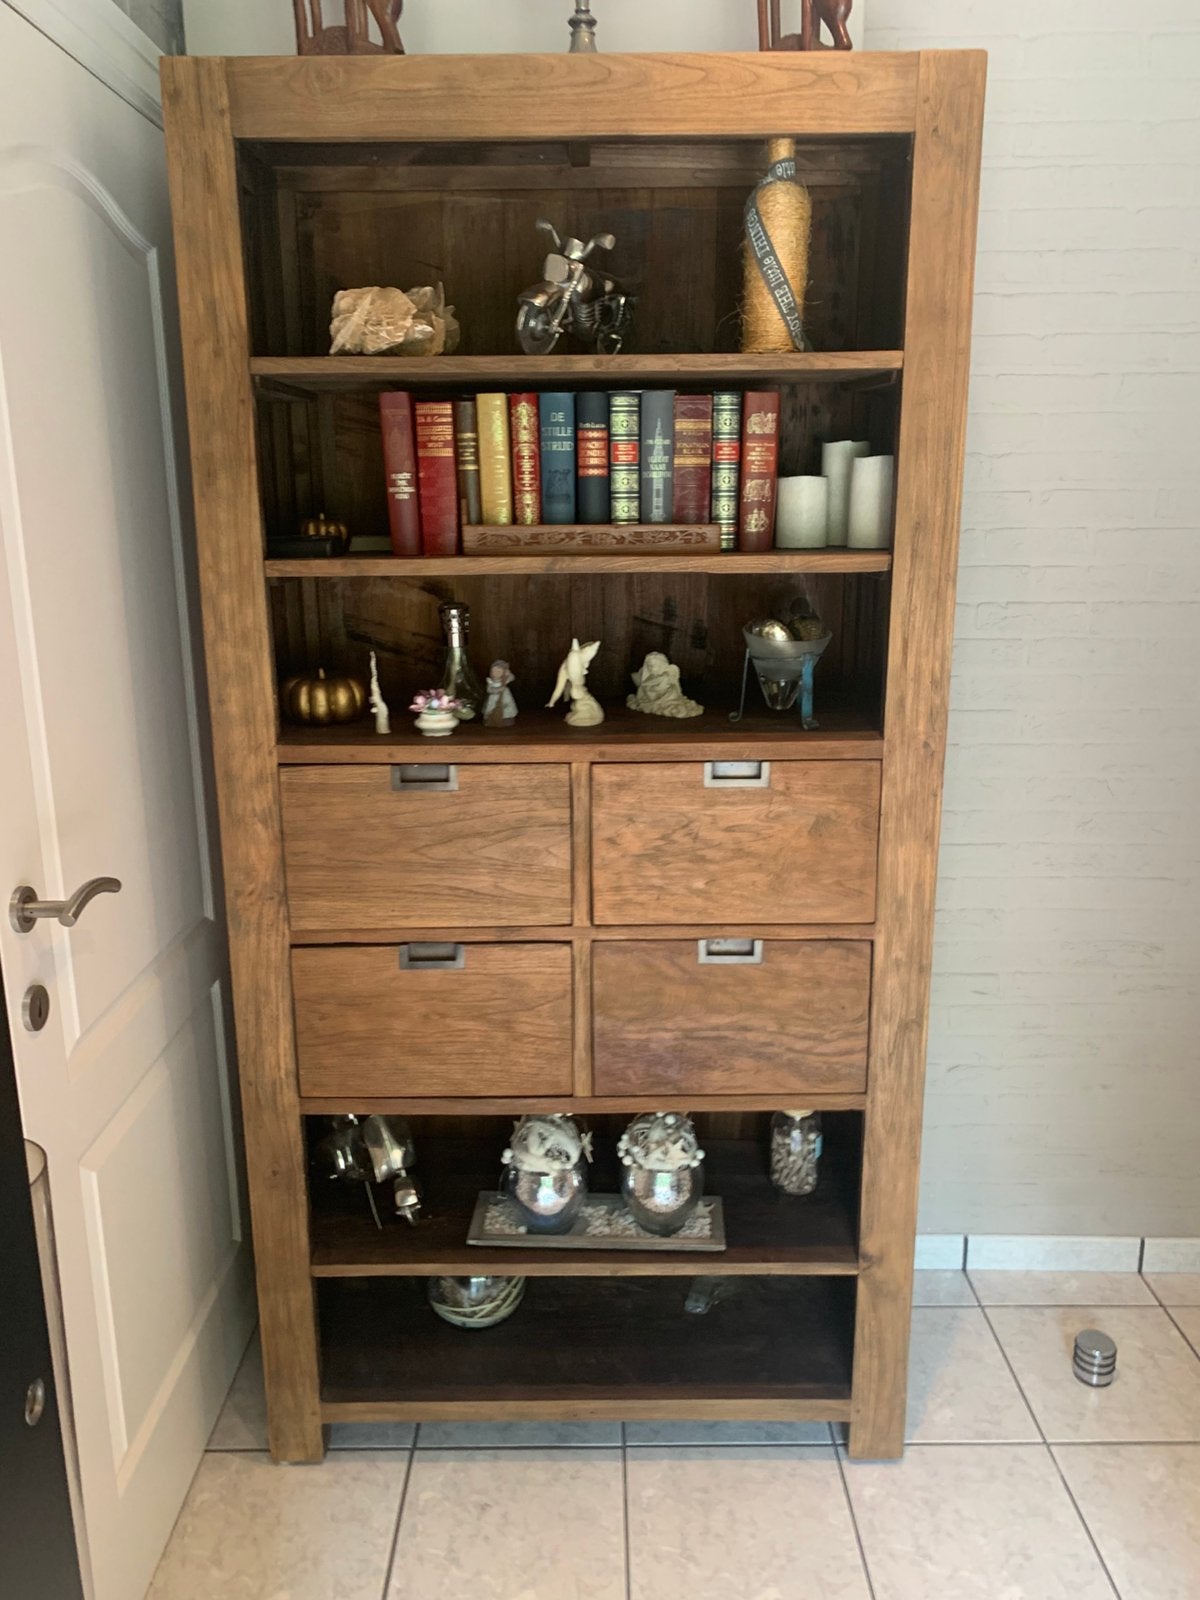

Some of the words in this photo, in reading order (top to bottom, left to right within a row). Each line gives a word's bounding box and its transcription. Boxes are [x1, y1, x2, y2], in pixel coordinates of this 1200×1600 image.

[748, 208, 770, 258] THINGS
[763, 256, 784, 287] little
[774, 285, 794, 314] THE
[541, 426, 574, 436] STILLE
[550, 412, 565, 422] DE
